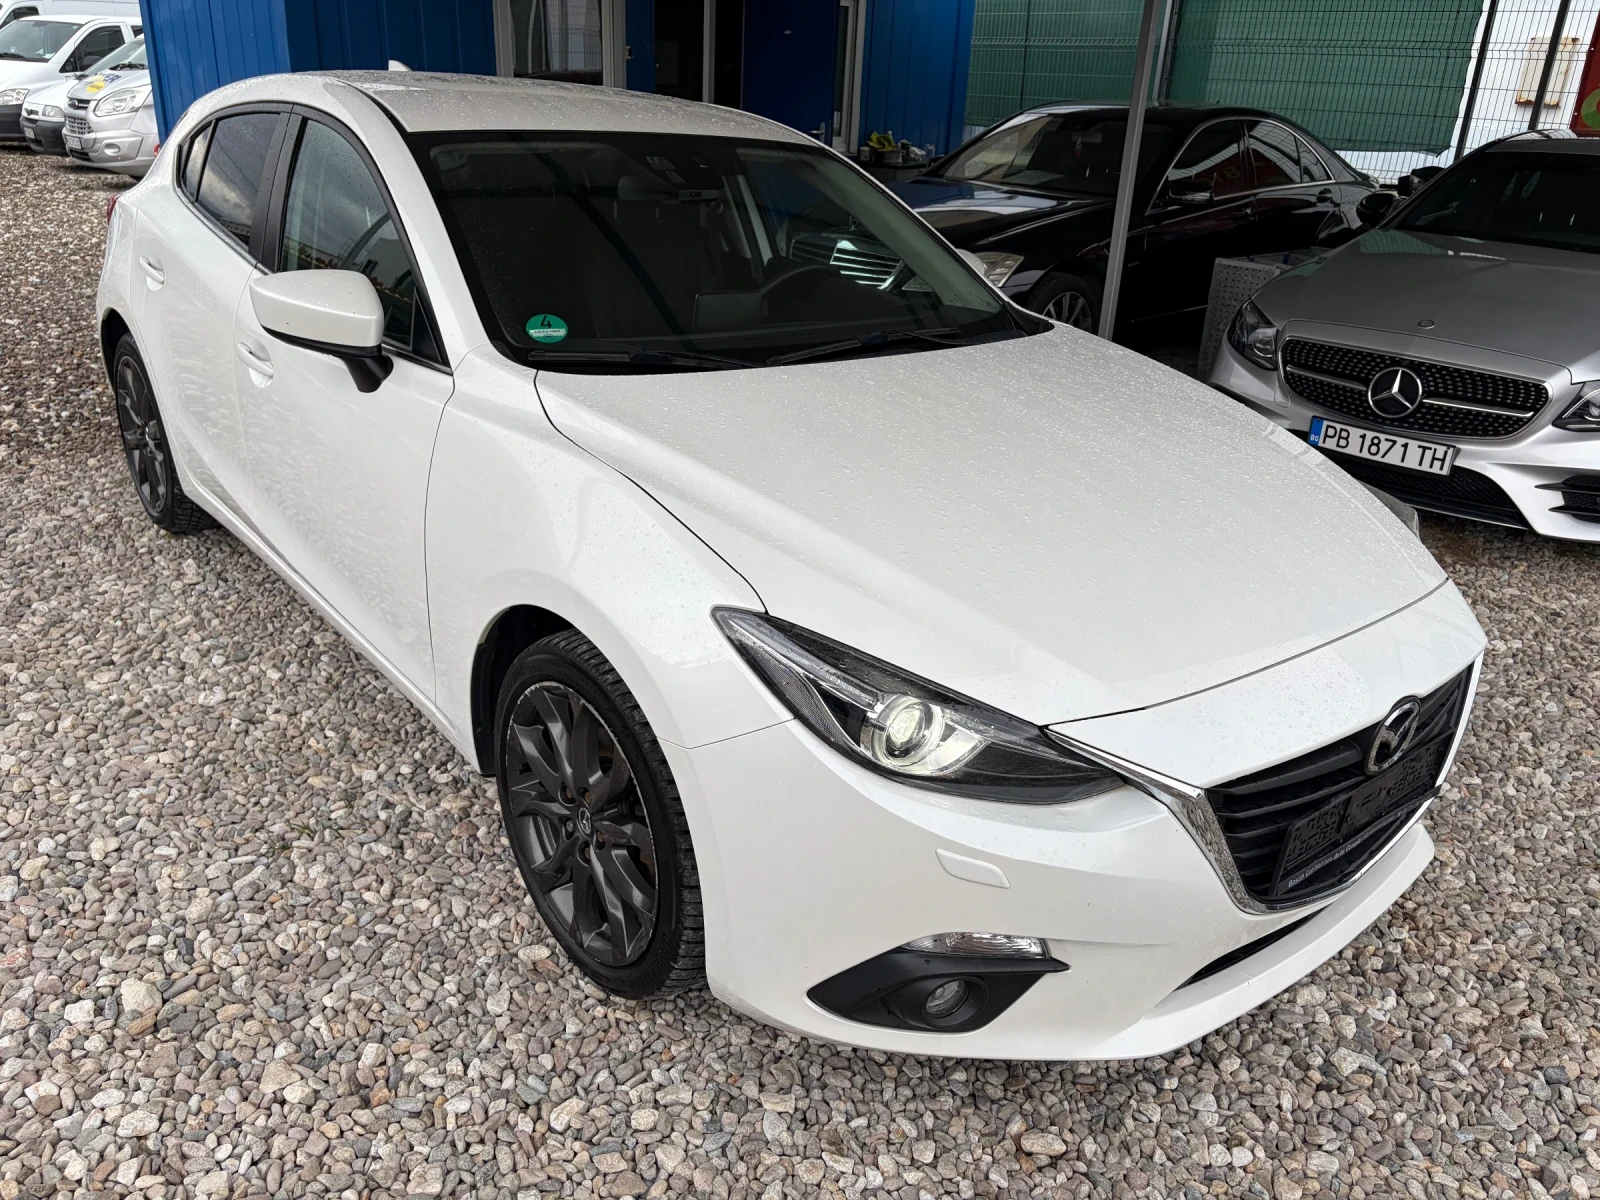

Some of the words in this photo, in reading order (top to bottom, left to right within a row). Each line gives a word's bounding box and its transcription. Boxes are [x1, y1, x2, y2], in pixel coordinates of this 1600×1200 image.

[540, 315, 552, 328] 4
[1310, 434, 1319, 442] BG
[1322, 424, 1351, 449] PB
[1358, 433, 1409, 463] 1871
[1417, 445, 1448, 471] TH
[1288, 873, 1305, 888] Bosch
